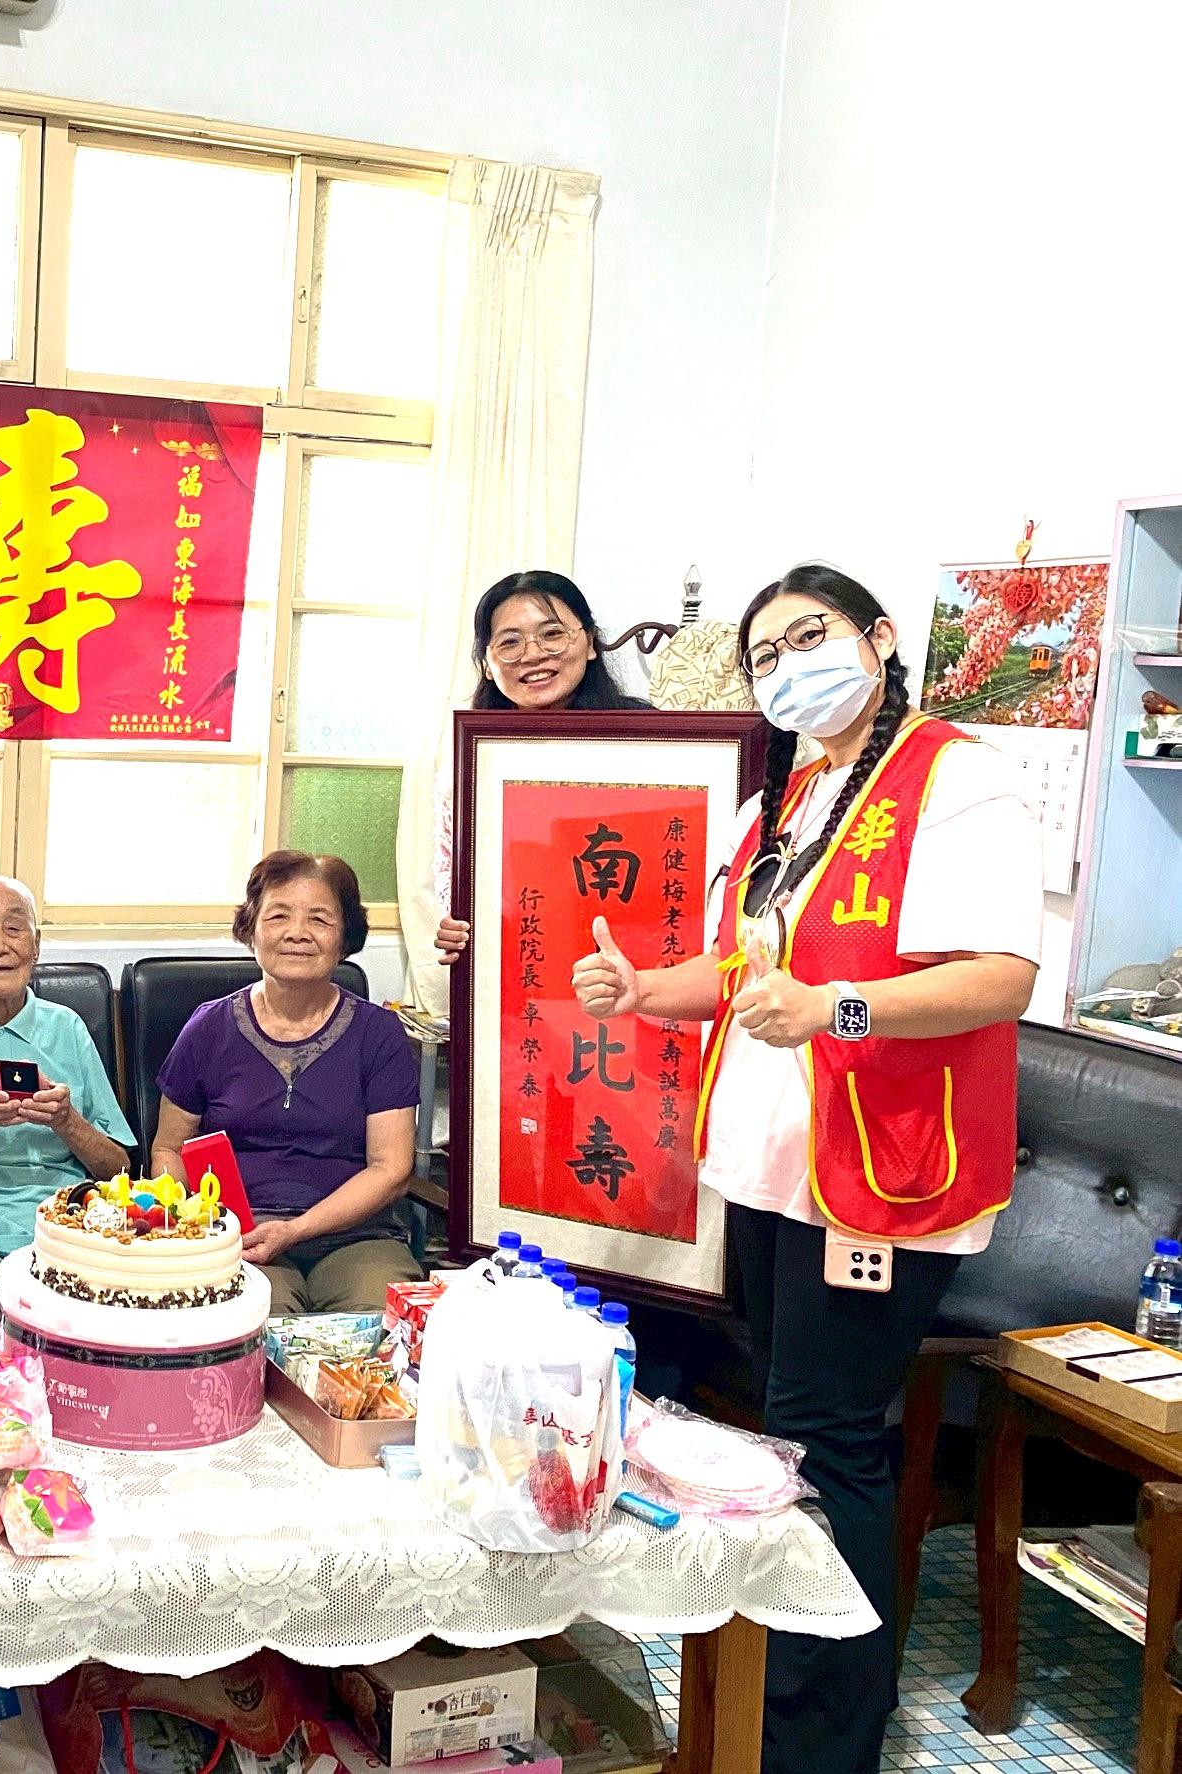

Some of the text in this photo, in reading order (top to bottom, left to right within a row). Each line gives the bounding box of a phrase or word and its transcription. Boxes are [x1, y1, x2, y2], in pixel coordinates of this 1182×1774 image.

[158, 464, 205, 711] 福如東海長流水
[653, 816, 689, 1151] 康健梅老先歲壽誕嵩慶
[831, 797, 899, 928] 華山
[518, 886, 546, 1099] 行政院長卓榮泰
[566, 823, 641, 1202] 南比壽
